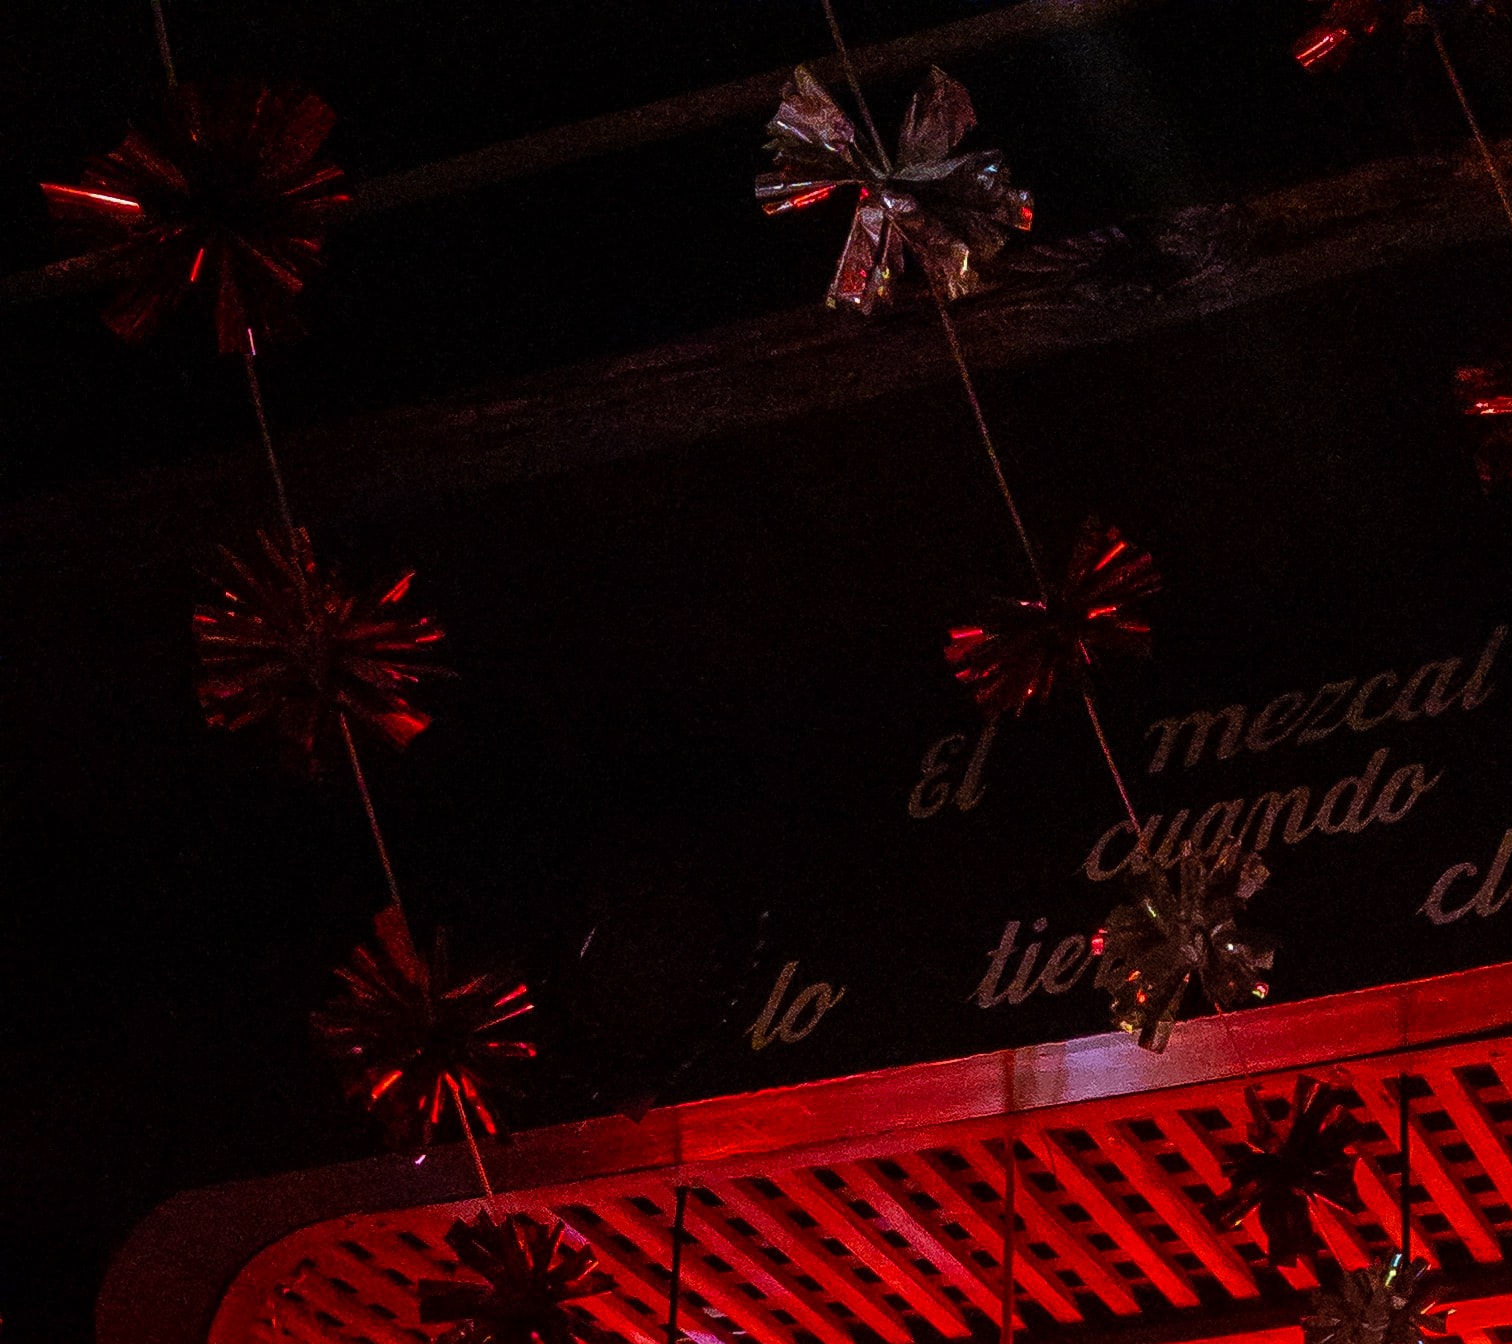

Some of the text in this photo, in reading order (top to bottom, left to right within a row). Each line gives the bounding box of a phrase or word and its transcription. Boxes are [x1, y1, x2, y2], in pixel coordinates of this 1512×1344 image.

[905, 722, 998, 820] El
[1145, 624, 1506, 776] mezcal
[744, 960, 849, 1053] lo
